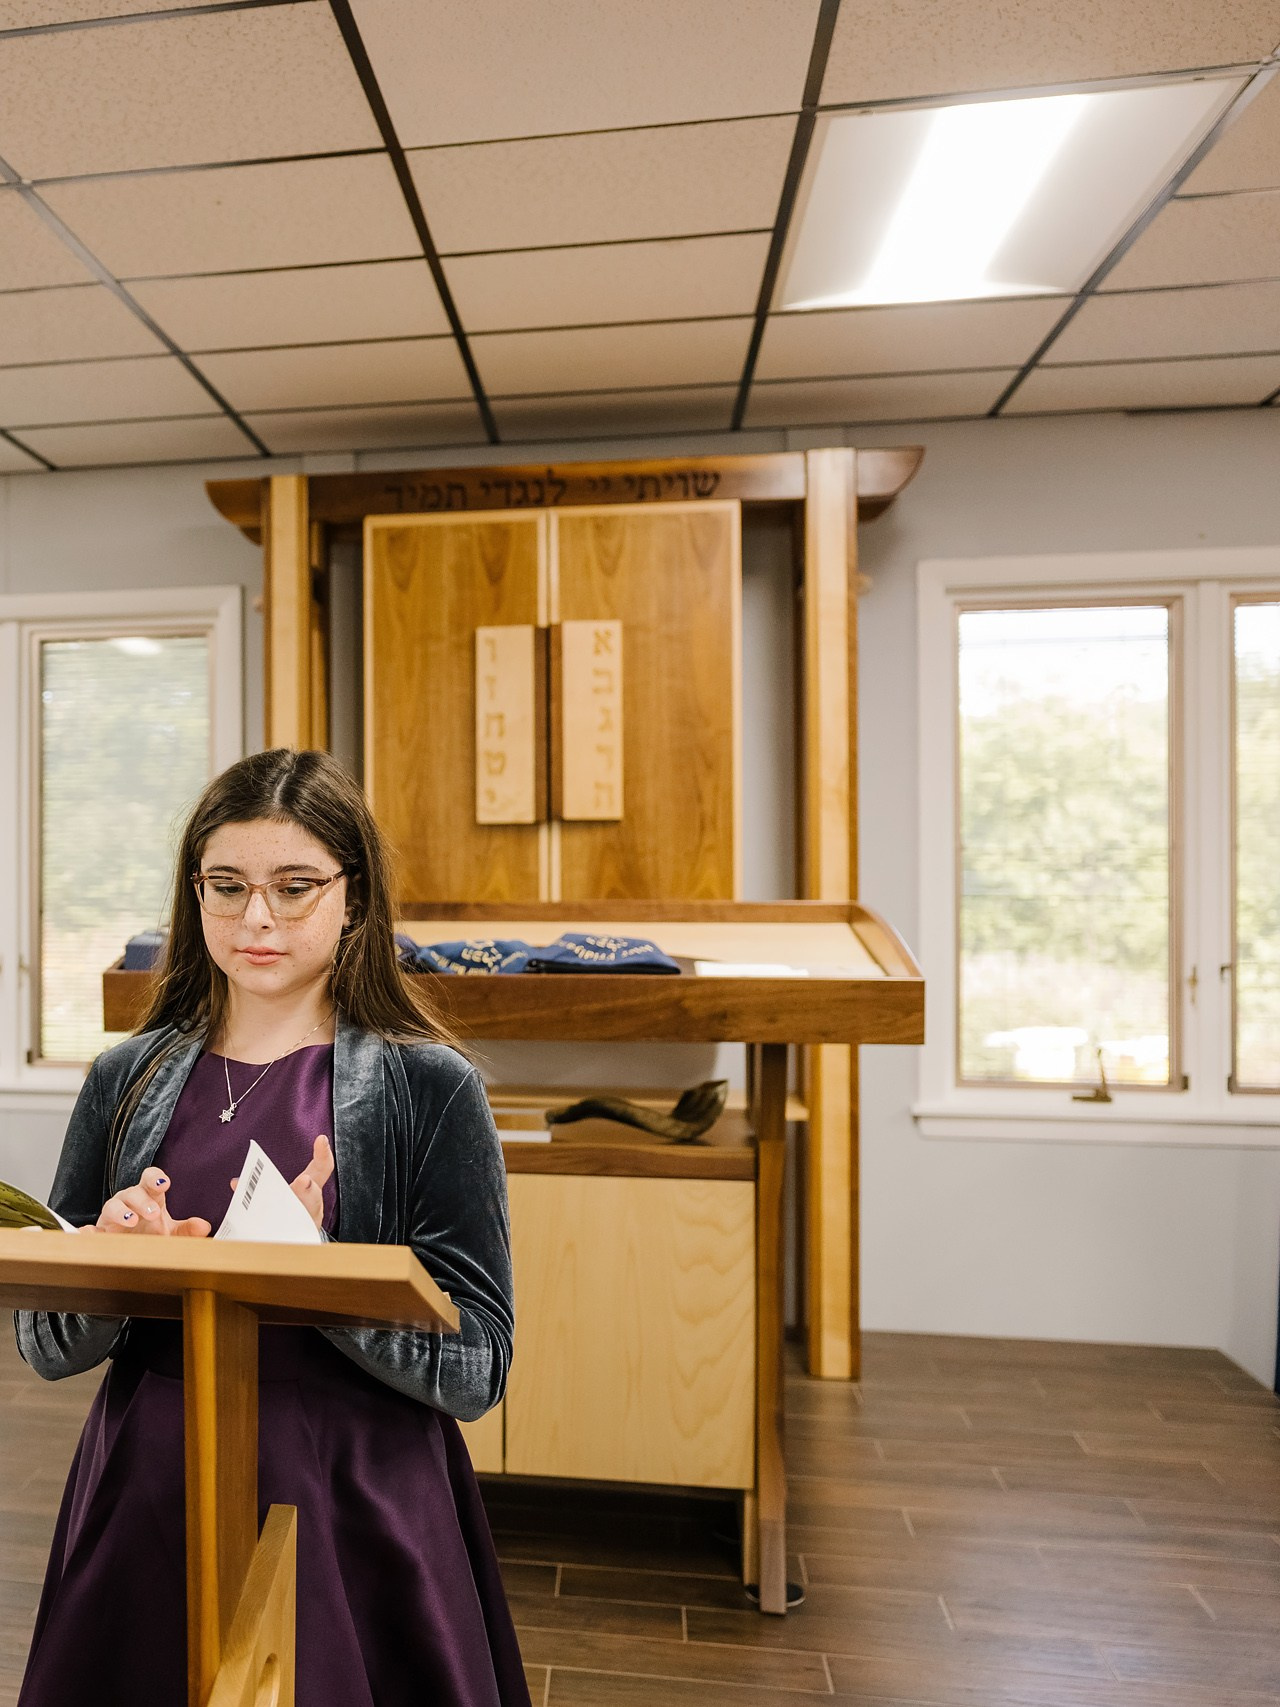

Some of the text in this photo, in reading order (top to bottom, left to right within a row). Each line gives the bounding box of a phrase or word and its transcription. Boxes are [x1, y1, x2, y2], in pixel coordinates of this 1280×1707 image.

[384, 468, 721, 509] שויתי יי לנגדי תמיד
